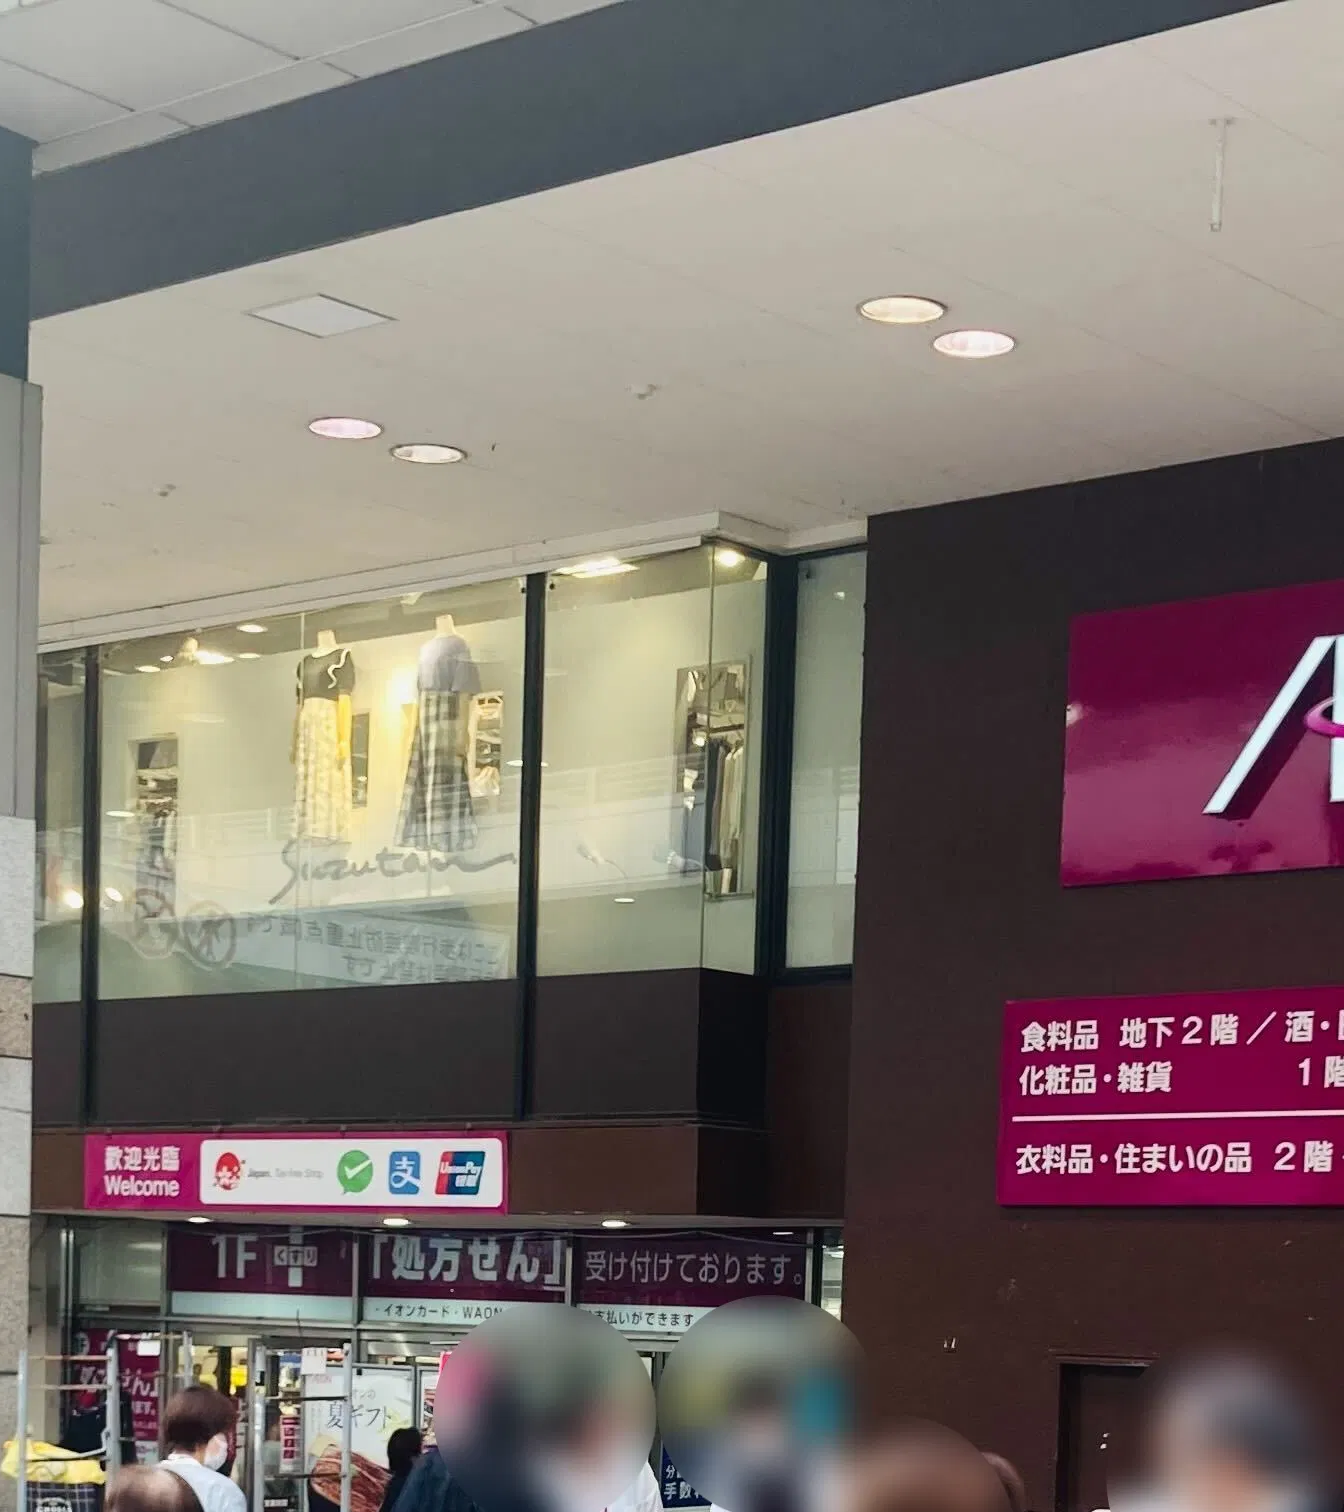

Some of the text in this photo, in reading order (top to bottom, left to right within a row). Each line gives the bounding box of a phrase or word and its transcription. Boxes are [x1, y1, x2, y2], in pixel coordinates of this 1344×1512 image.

[1020, 1019, 1099, 1053] 食料品
[1120, 1013, 1239, 1049] 地下2階
[1019, 1061, 1172, 1095] 化粧品・雑貨
[1016, 1142, 1252, 1175] 衣料品・住まいの品
[103, 1174, 180, 1197] Welcome
[212, 1235, 257, 1279] 1F
[664, 1481, 700, 1500] 手数
